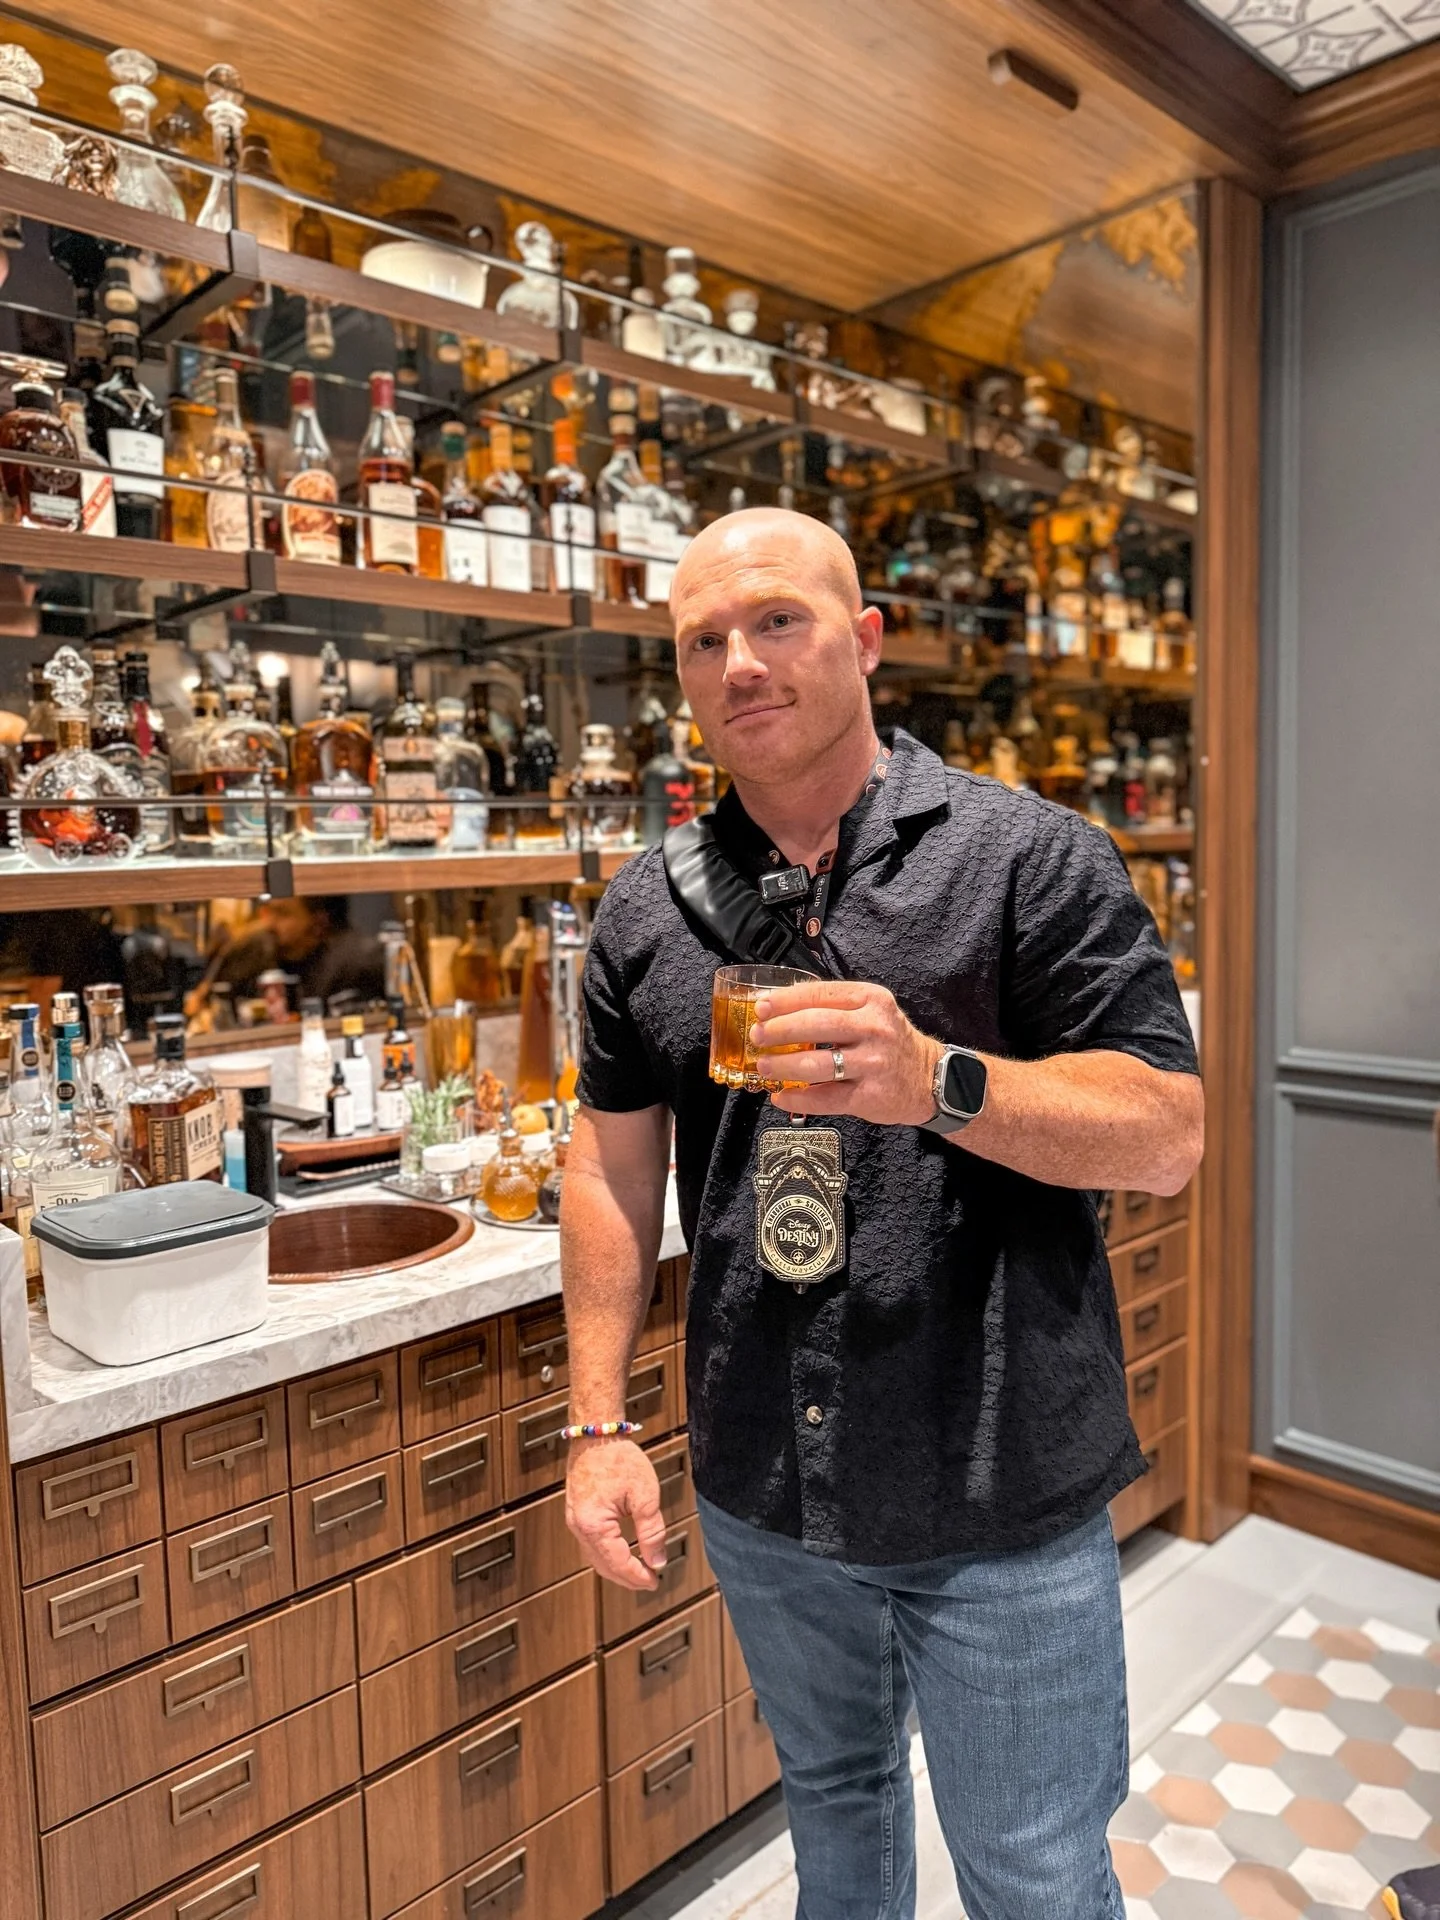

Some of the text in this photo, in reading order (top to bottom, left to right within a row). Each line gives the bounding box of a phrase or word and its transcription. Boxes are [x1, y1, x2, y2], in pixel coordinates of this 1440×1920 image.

[814, 887, 823, 908] club
[188, 1113, 212, 1146] KNOB
[805, 1200, 831, 1227] SAILINGS
[785, 1218, 812, 1231] Disney
[777, 1227, 820, 1248] DESTINY
